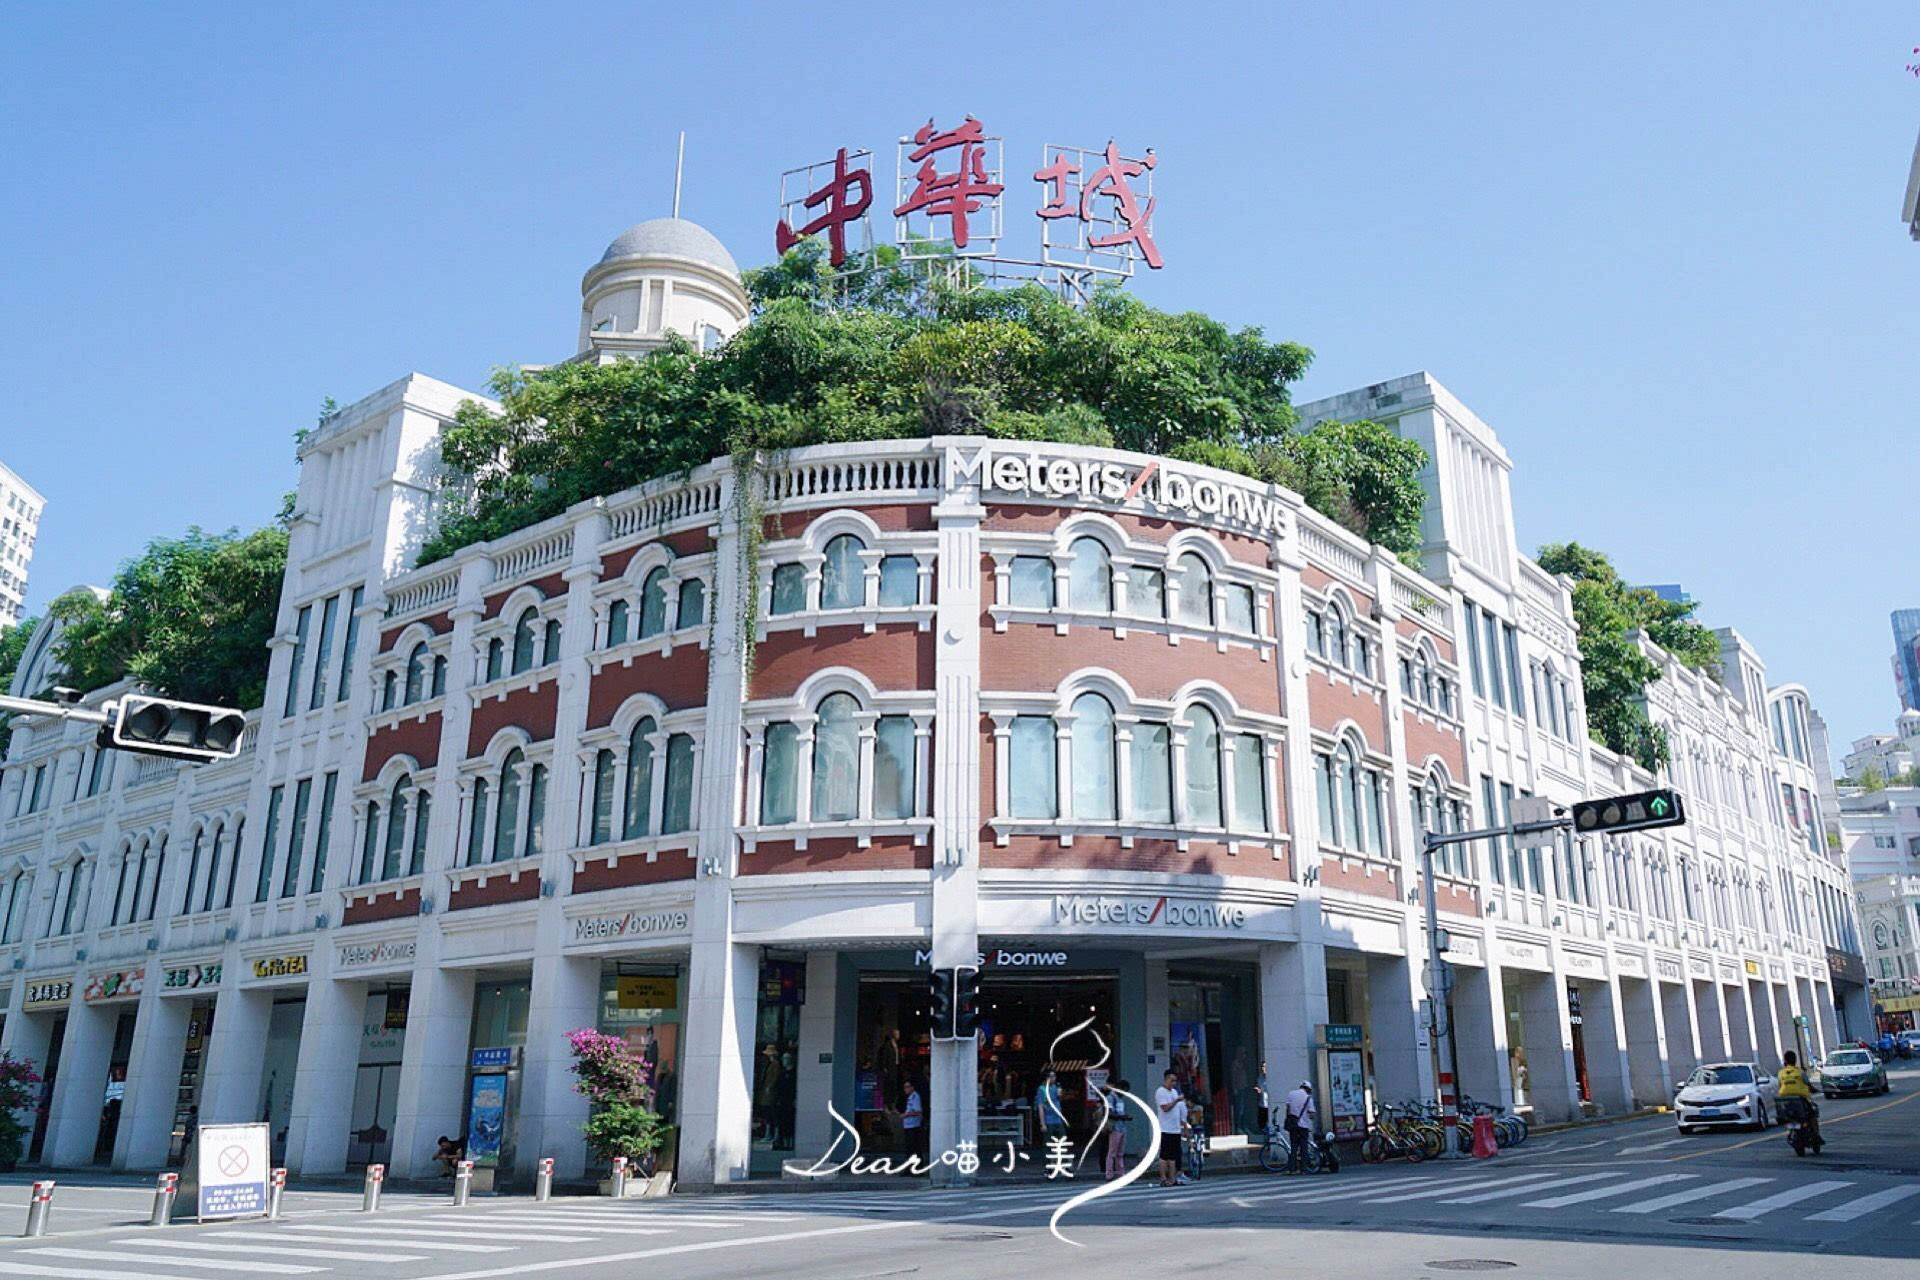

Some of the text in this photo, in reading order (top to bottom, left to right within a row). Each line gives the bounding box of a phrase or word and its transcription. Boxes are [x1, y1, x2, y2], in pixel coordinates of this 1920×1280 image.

[944, 446, 1288, 532] Meters/bonwe
[575, 911, 688, 939] Meters/bonwe
[1052, 895, 1247, 928] Meters/bonwe
[915, 950, 1068, 966] Ms/bonwe
